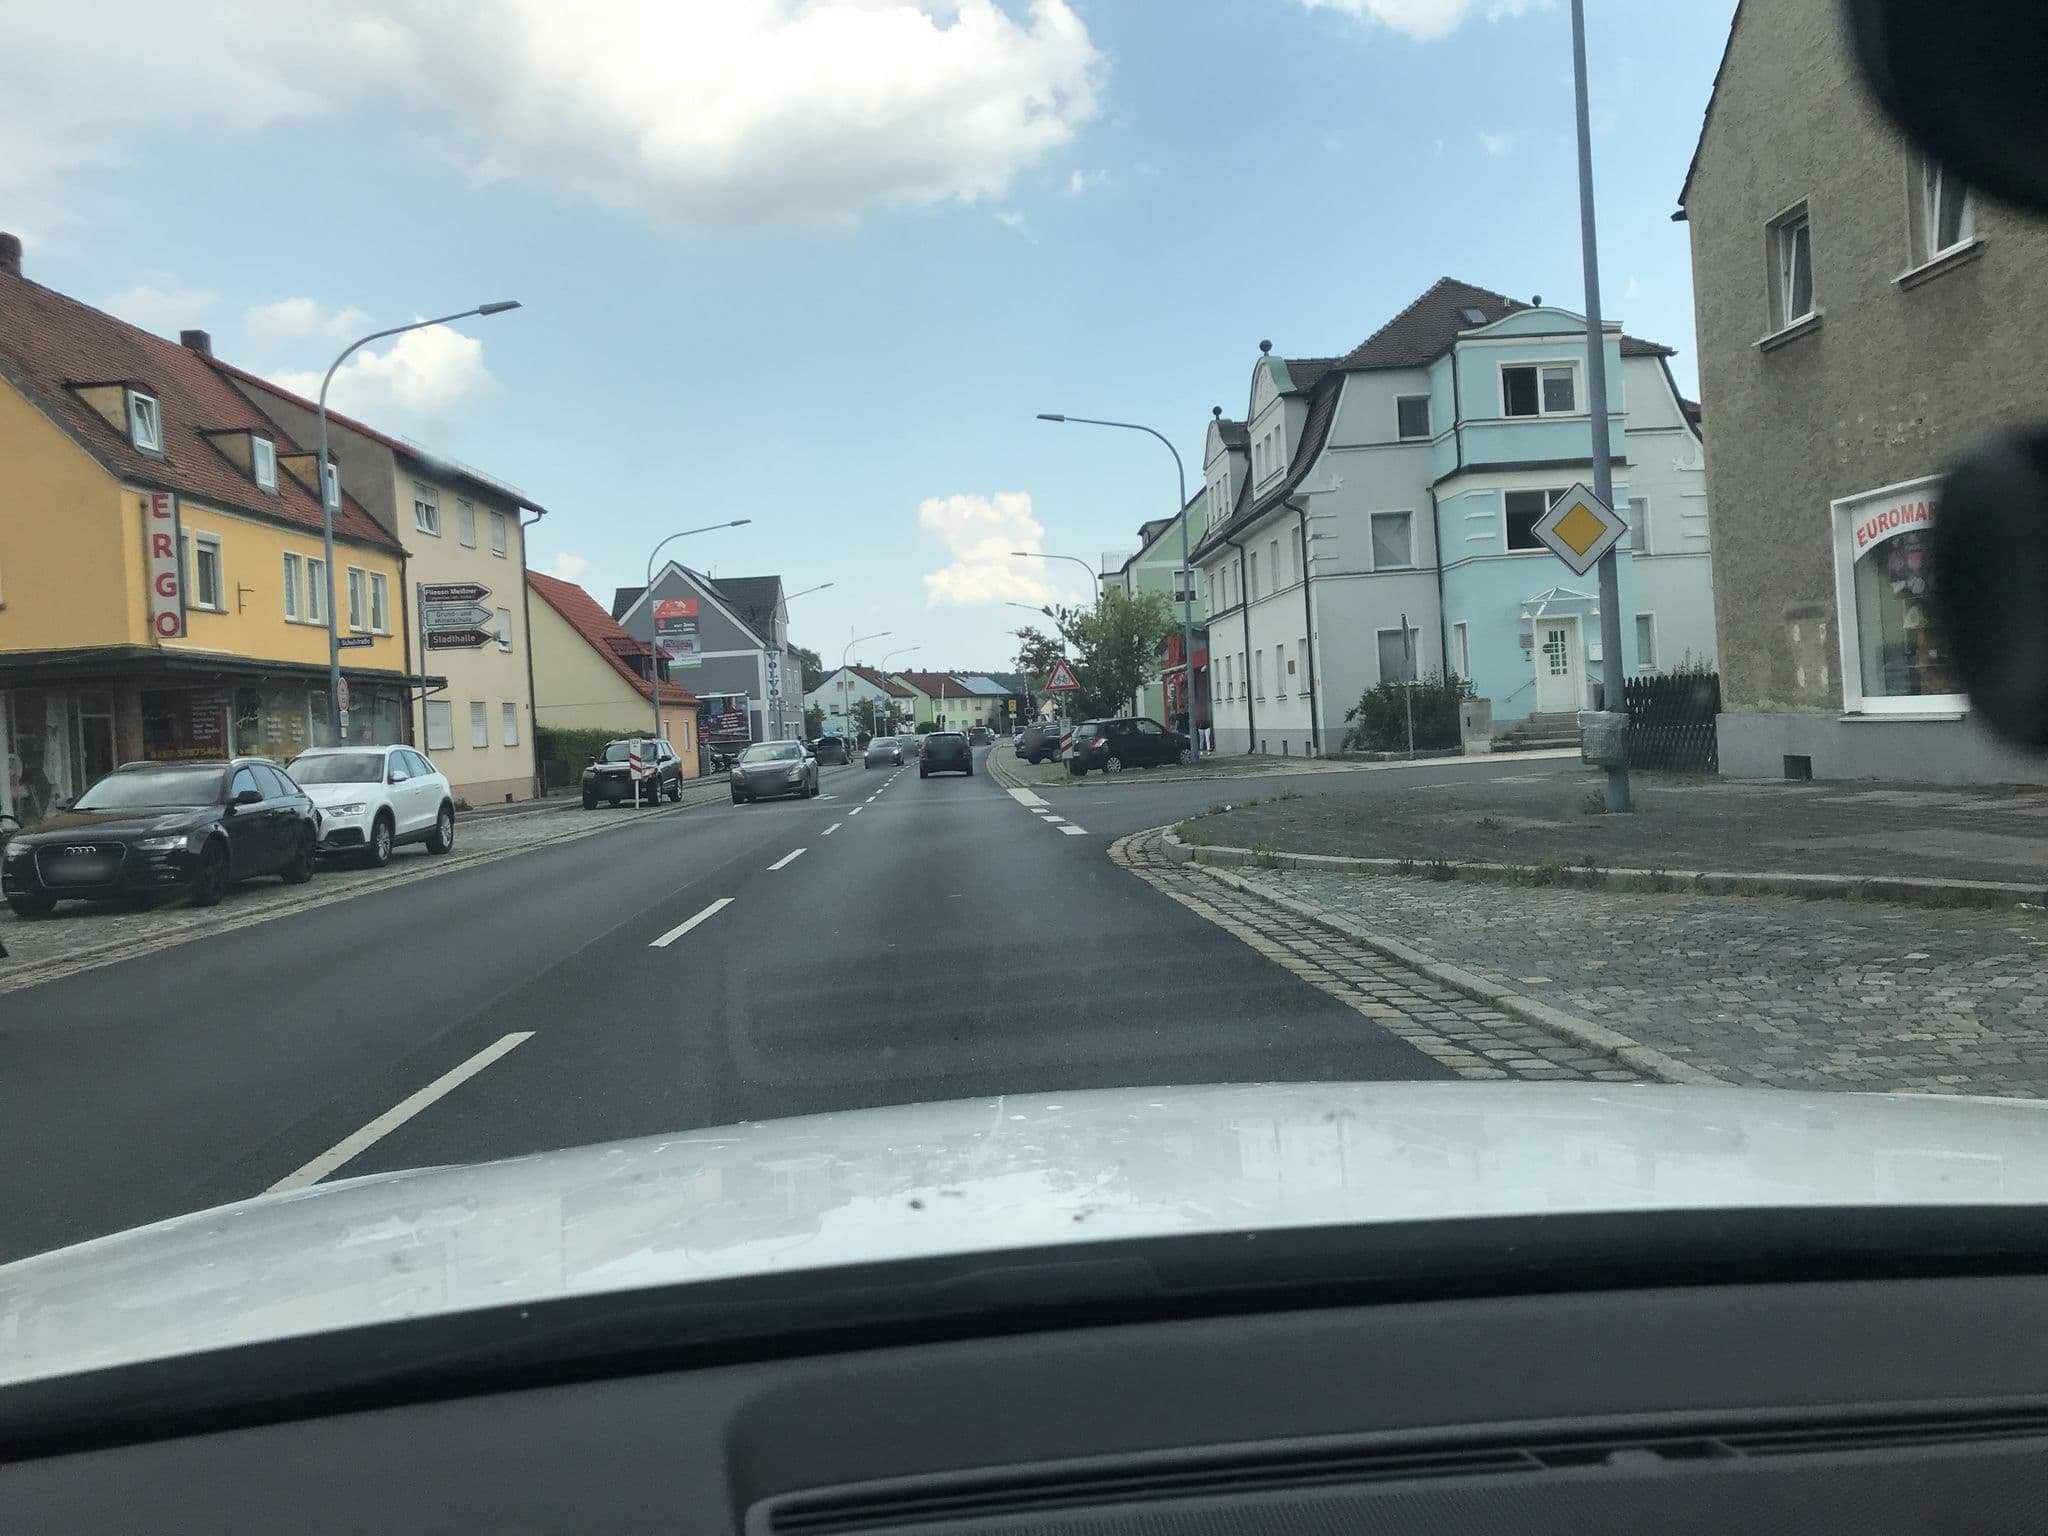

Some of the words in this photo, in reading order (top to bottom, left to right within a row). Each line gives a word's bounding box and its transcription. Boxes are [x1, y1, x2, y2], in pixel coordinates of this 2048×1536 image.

[152, 494, 180, 637] ERGO
[432, 633, 476, 644] Stadthalle
[766, 652, 780, 697] VOLVO
